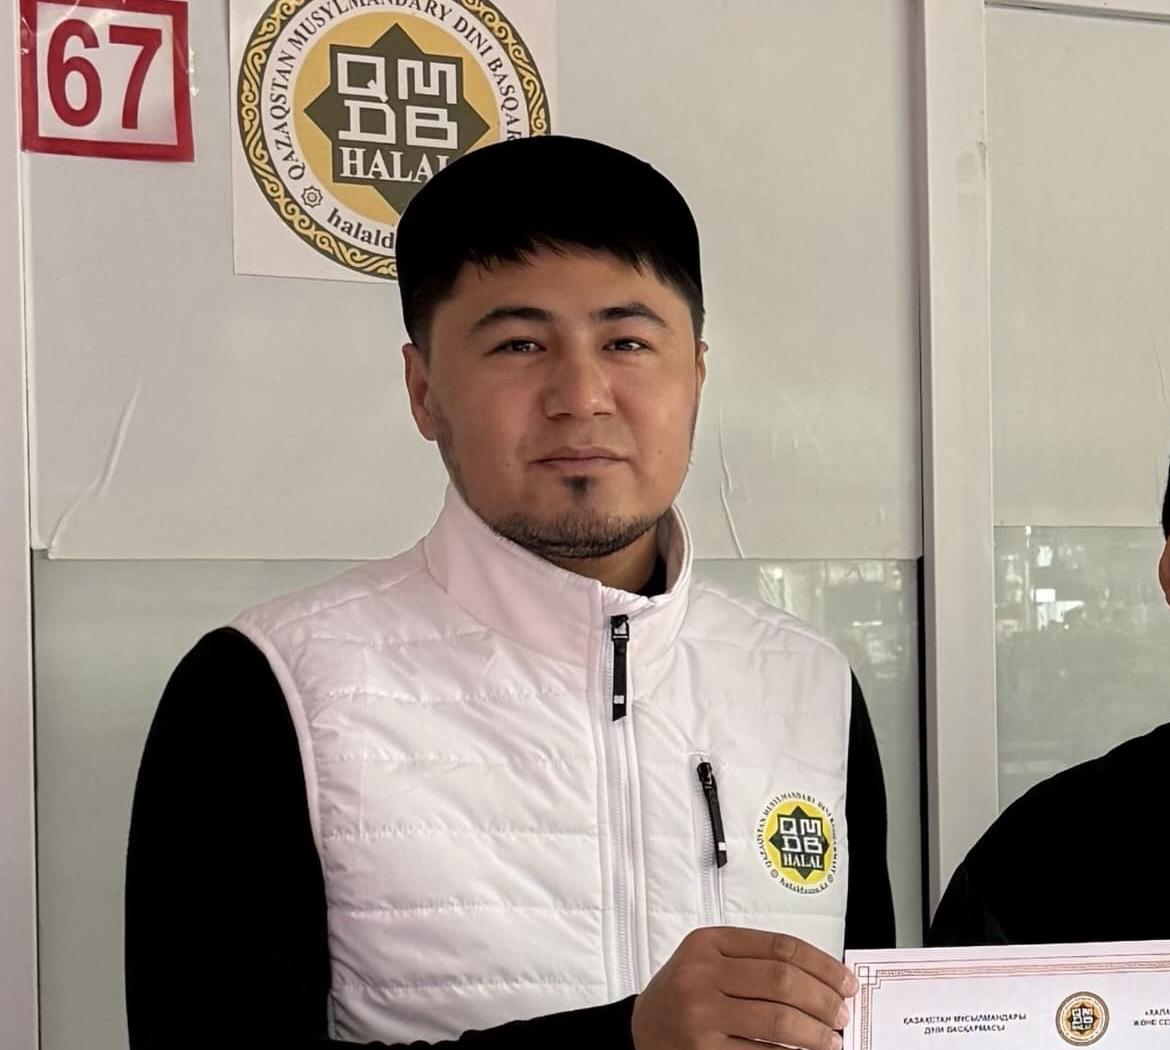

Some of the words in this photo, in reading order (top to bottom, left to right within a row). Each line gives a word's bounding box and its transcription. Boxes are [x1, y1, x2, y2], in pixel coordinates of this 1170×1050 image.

[46, 19, 163, 130] 67
[269, 50, 306, 181] QAZAQSTAN
[290, 0, 453, 51] MUSYLARY
[452, 16, 493, 57] DINI
[327, 208, 395, 249] halald
[783, 852, 824, 868] HALAL
